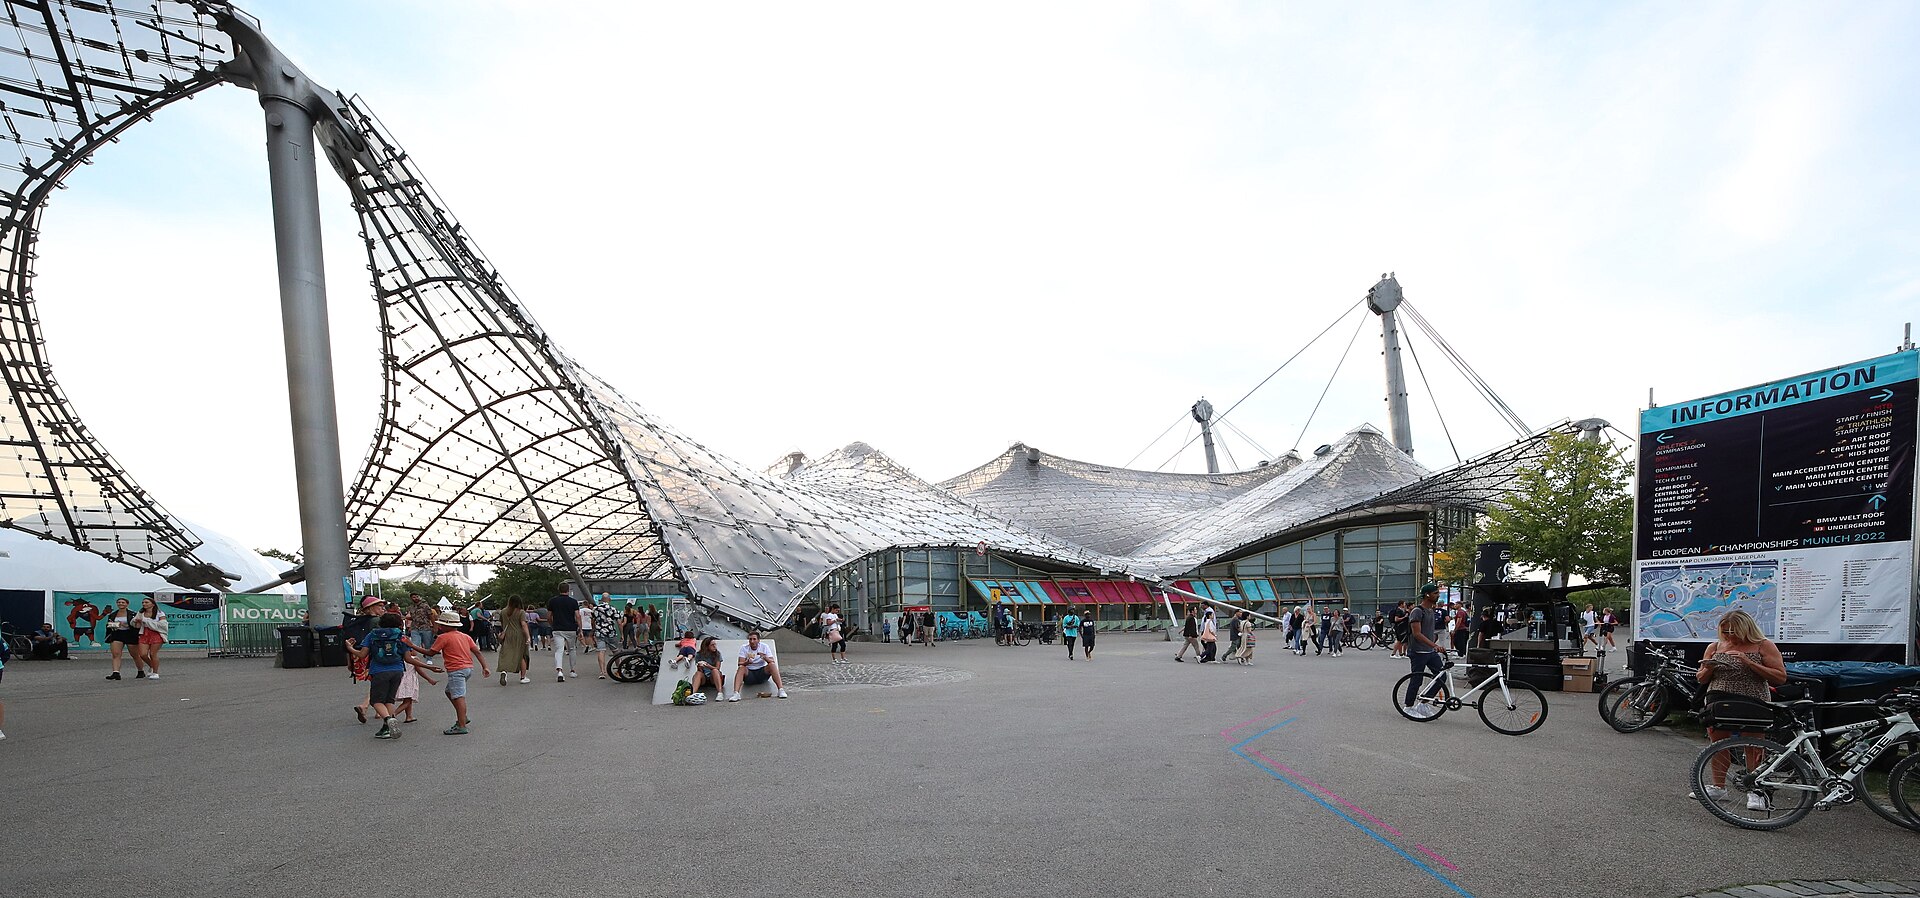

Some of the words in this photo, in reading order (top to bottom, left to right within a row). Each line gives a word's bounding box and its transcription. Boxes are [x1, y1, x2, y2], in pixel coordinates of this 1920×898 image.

[1670, 365, 1876, 424] INFORMATION
[1836, 415, 1858, 423] START
[1866, 409, 1892, 418] FINISH
[1848, 416, 1893, 428] TRIATHLON
[1835, 428, 1858, 436] START
[1866, 422, 1891, 431] FINISH
[1656, 443, 1705, 455] OLYMPIASTADION
[1831, 444, 1867, 453] CREATIVE
[1869, 439, 1890, 447] ROOF
[1656, 463, 1698, 473] OLYMPIAHALLE
[1772, 470, 1792, 478] MAIN
[1794, 462, 1854, 474] ACCREDITATION
[1857, 456, 1889, 466] CENTRE
[1828, 470, 1854, 478] MEDIA
[1857, 464, 1889, 474] CENTRE
[1808, 477, 1854, 488] VOLUNTEER
[1856, 472, 1888, 481] CENTRE
[1828, 520, 1885, 530] UNDERGROUND
[1653, 547, 1700, 557] EUROPEAN
[1719, 538, 1799, 552] CHAMPIONSHIPS
[1803, 535, 1850, 545] MUNICH
[1854, 532, 1885, 540] 2022
[1850, 737, 1891, 774] CUBE
